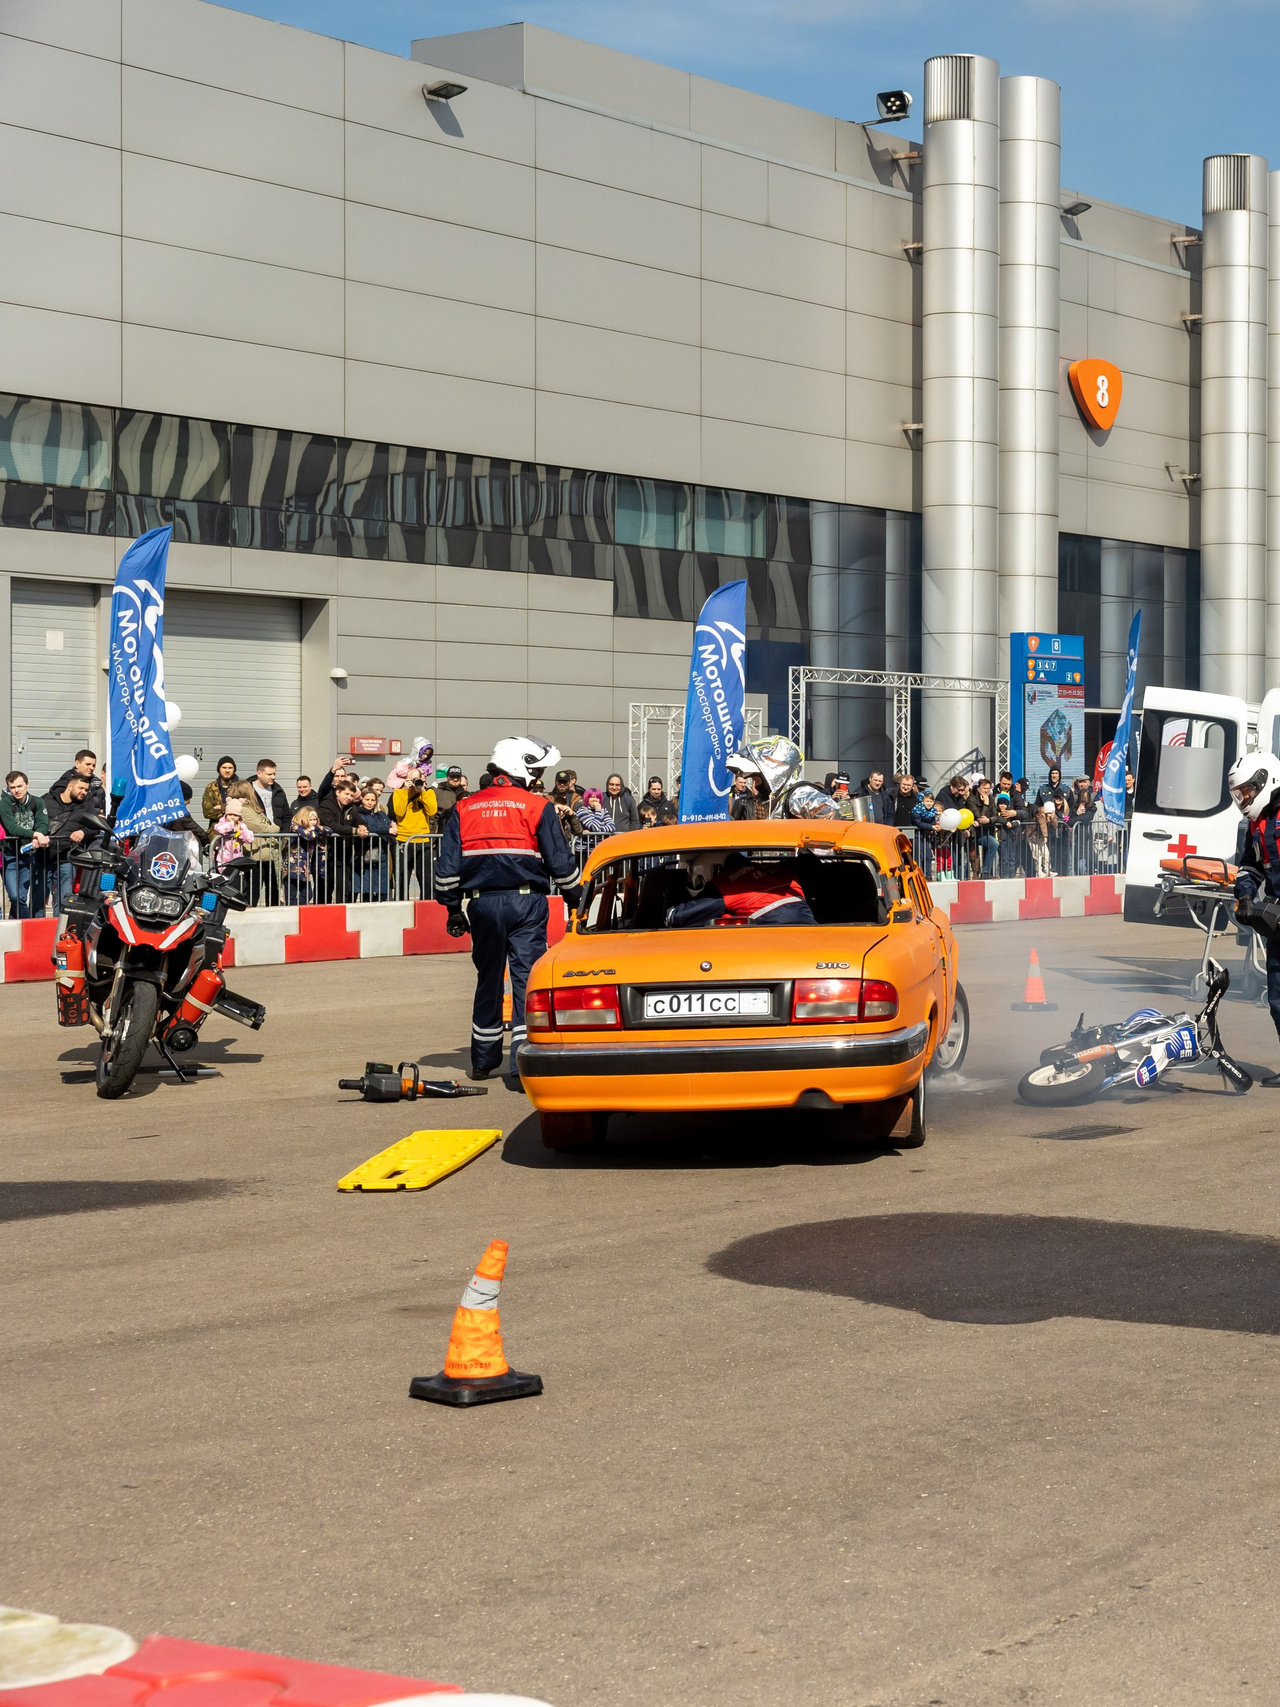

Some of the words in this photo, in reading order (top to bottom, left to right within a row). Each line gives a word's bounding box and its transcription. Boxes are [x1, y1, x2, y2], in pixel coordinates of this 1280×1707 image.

[1096, 375, 1109, 407] 8
[117, 608, 168, 760] Мотошола
[698, 643, 735, 774] Мотошкол
[481, 810, 507, 818] СЛУЖБА
[816, 961, 851, 969] 3110
[67, 997, 77, 1023] ROLF
[1180, 1030, 1193, 1058] BSE
[1140, 1066, 1150, 1084] BSE
